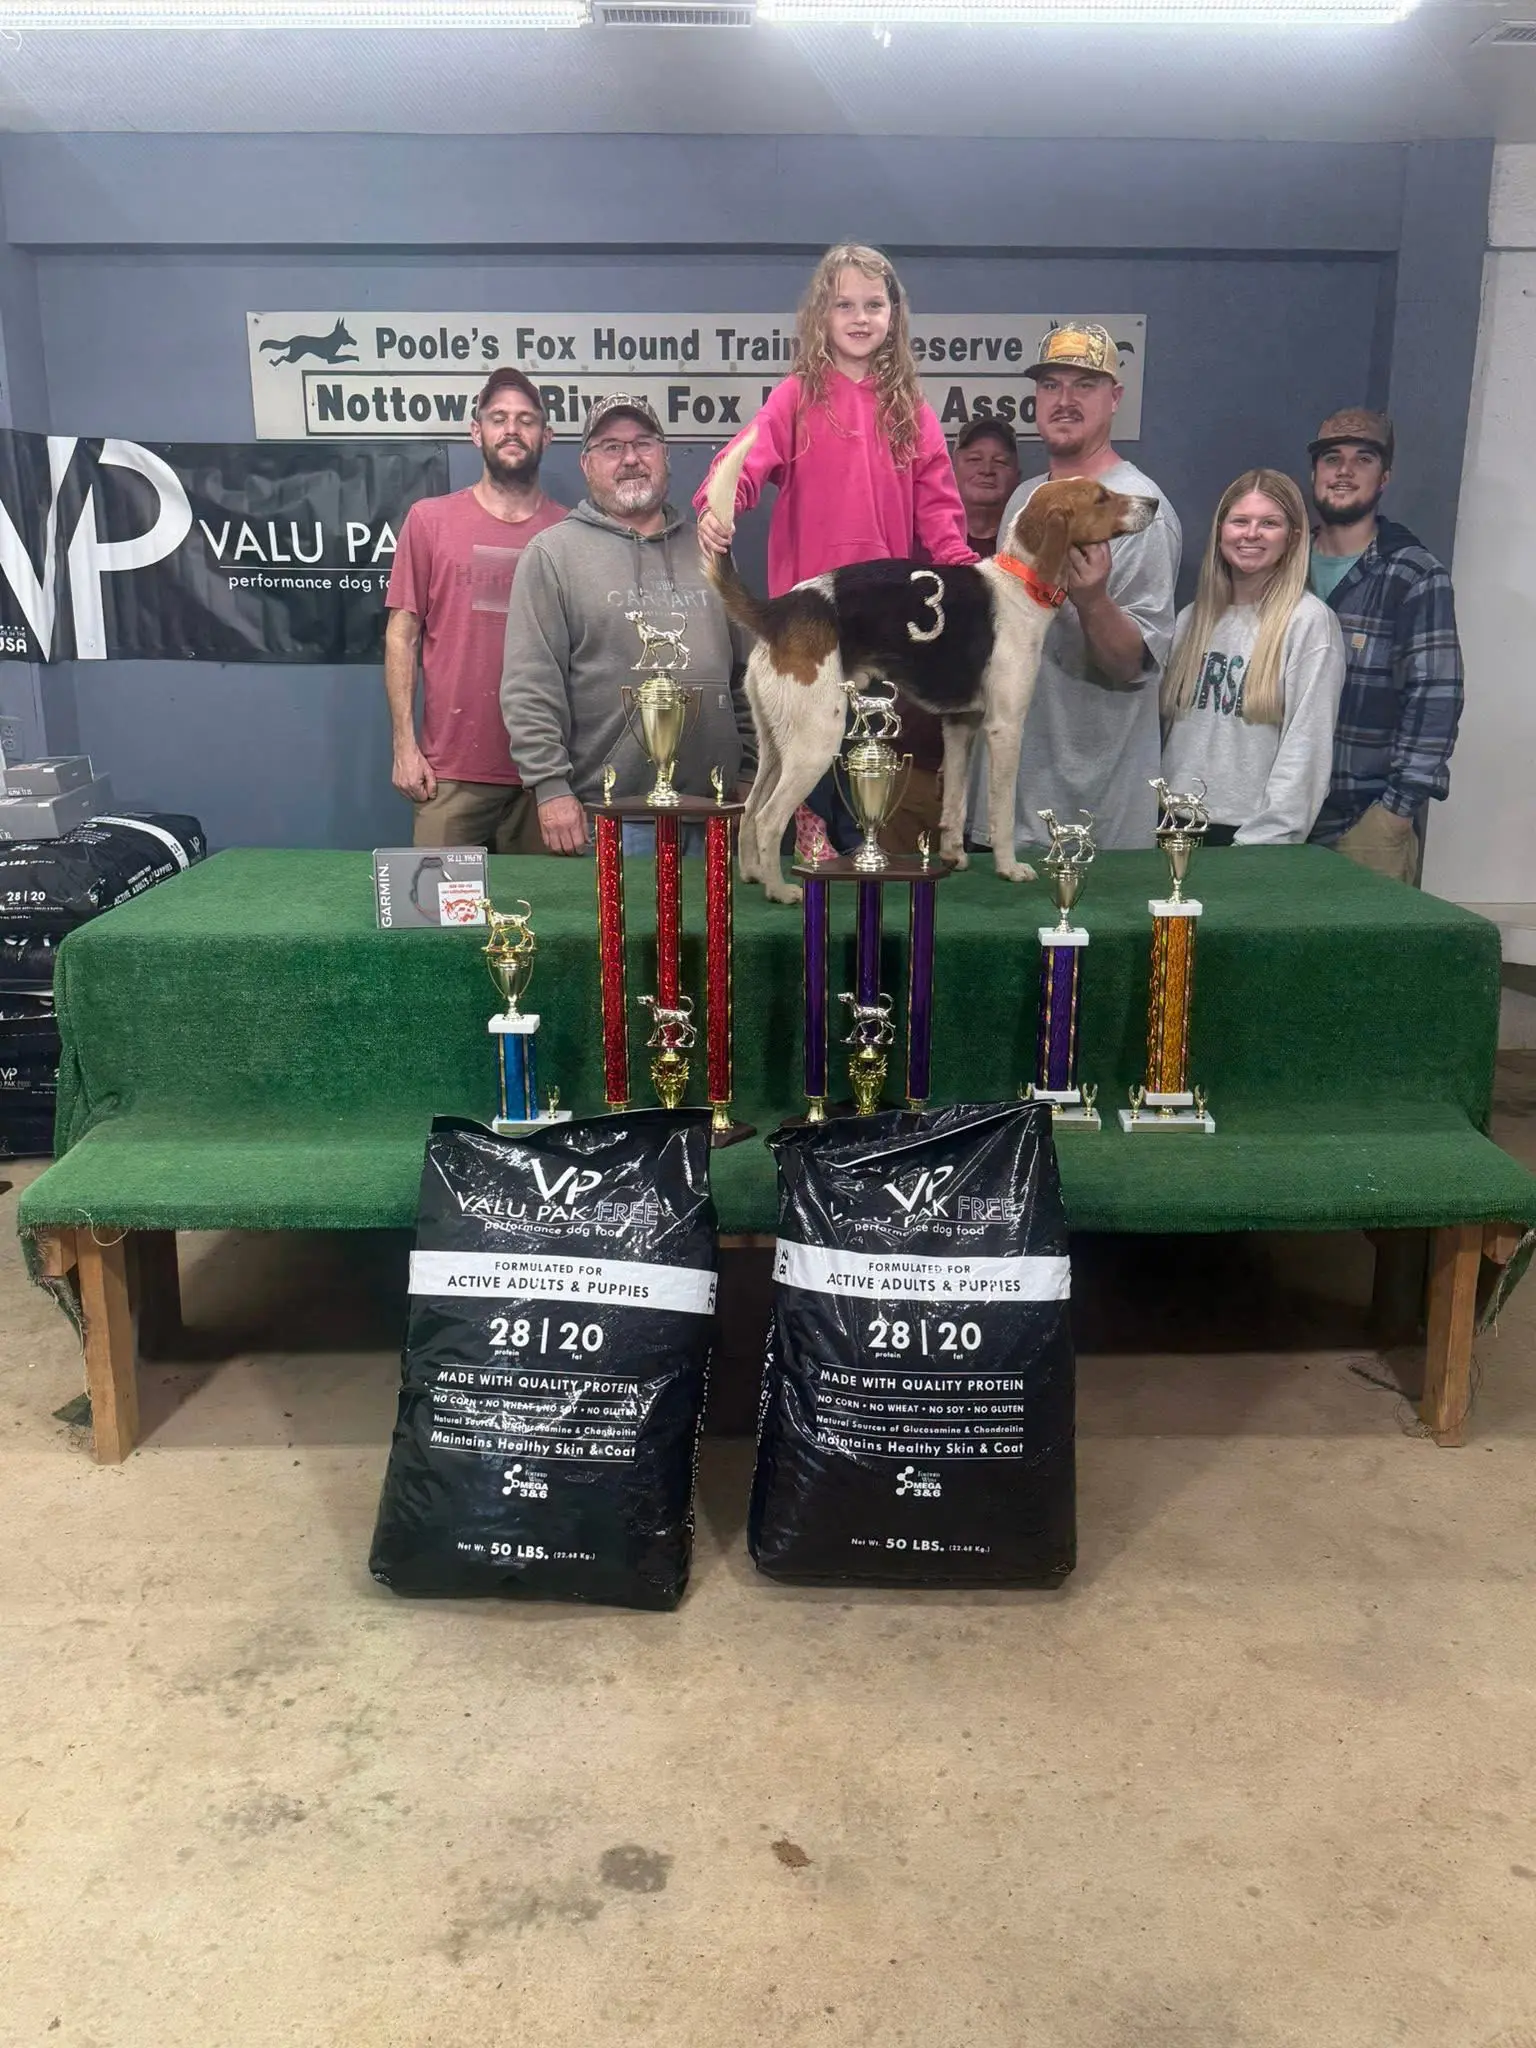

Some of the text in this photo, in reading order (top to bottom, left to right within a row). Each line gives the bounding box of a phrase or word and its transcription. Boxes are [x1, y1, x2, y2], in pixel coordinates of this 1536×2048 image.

[376, 327, 1022, 361] Poole's Fox Hound Train eserve
[318, 383, 478, 422] Nottow
[668, 386, 741, 423] Fox
[941, 386, 1036, 423] Asso
[199, 520, 398, 563] VALU PA
[229, 573, 332, 590] performance
[339, 574, 371, 592] dog
[907, 570, 945, 642] 3
[7, 891, 46, 901] 28 20
[530, 1158, 602, 1205] VP
[883, 1165, 954, 1212] VP
[457, 1191, 659, 1226] VALU PAK FREE
[904, 1195, 949, 1228] PAK
[957, 1195, 1015, 1221] FREE
[484, 1220, 561, 1235] performance
[566, 1224, 590, 1237] dog
[932, 1222, 953, 1236] dog
[957, 1225, 985, 1236] food
[495, 1261, 602, 1276] FORMULATED FOR
[868, 1262, 970, 1274] FORMULATED FOR
[447, 1275, 649, 1299] ACTIVE ADULTS & PUPPIES
[827, 1272, 1021, 1293] ACTIVE ADULTS & PUPPIES
[489, 1318, 604, 1352] 28 20
[868, 1320, 982, 1351] 28 20
[953, 1352, 963, 1360] fat
[437, 1371, 639, 1394] MADE WITH QUALITY PROTEIN
[820, 1369, 1024, 1391] MADE WITH QUALITY PROTEIN
[433, 1394, 447, 1403] NO
[450, 1396, 477, 1408] CORN
[485, 1400, 499, 1408] NO
[587, 1407, 600, 1415] NO
[817, 1394, 832, 1403] NO
[835, 1396, 860, 1409] CORN
[869, 1403, 884, 1412] NO
[887, 1404, 918, 1413] WHEAT
[946, 1405, 964, 1413] SOY
[974, 1405, 988, 1413] NO
[991, 1405, 1024, 1413] GLUTEN
[433, 1414, 462, 1425] Natural
[816, 1414, 1024, 1434] Natural Sources of Glucosamine & Chondroitin
[430, 1431, 636, 1457] Maintains Healthy Skin & Coat
[817, 1431, 1024, 1456] Maintains Healthy Skin & Coat
[457, 1542, 471, 1551] Net
[474, 1543, 487, 1552] Wt.
[490, 1542, 512, 1556] 50
[517, 1545, 549, 1560] LBS.
[885, 1538, 907, 1549] 50
[912, 1539, 945, 1552] LBS.
